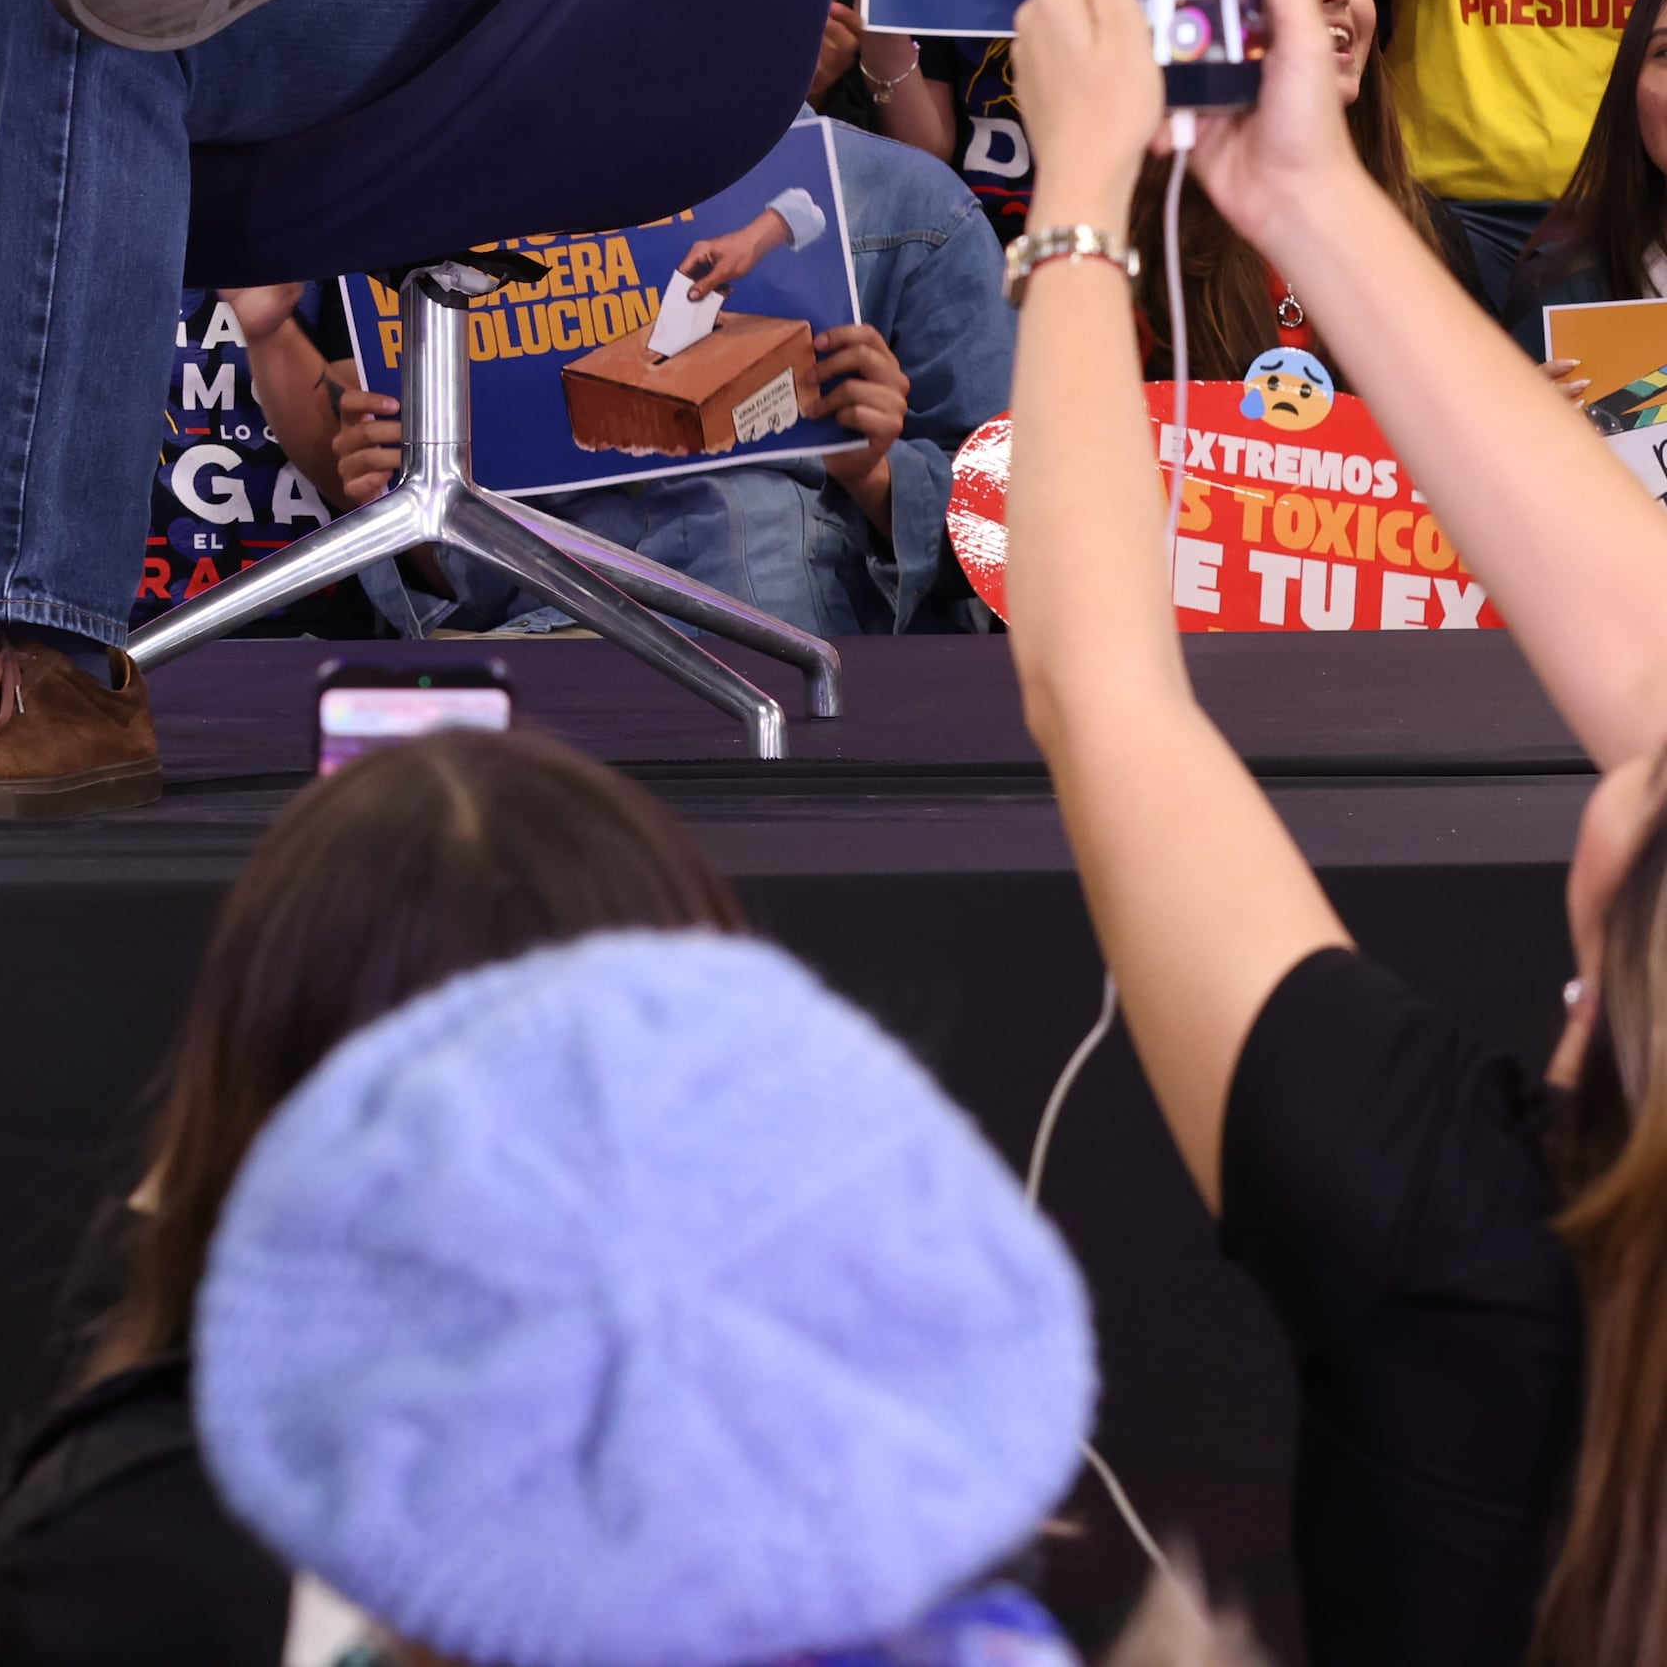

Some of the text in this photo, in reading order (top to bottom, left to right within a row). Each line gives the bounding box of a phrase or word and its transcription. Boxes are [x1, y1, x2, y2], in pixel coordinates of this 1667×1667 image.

[219, 424, 252, 441] LO
[1159, 423, 1399, 500] EXTREMOS
[193, 532, 224, 550] EL
[1233, 484, 1475, 574] TÓXICO
[1248, 549, 1358, 631] TU
[1380, 570, 1488, 631] EX
